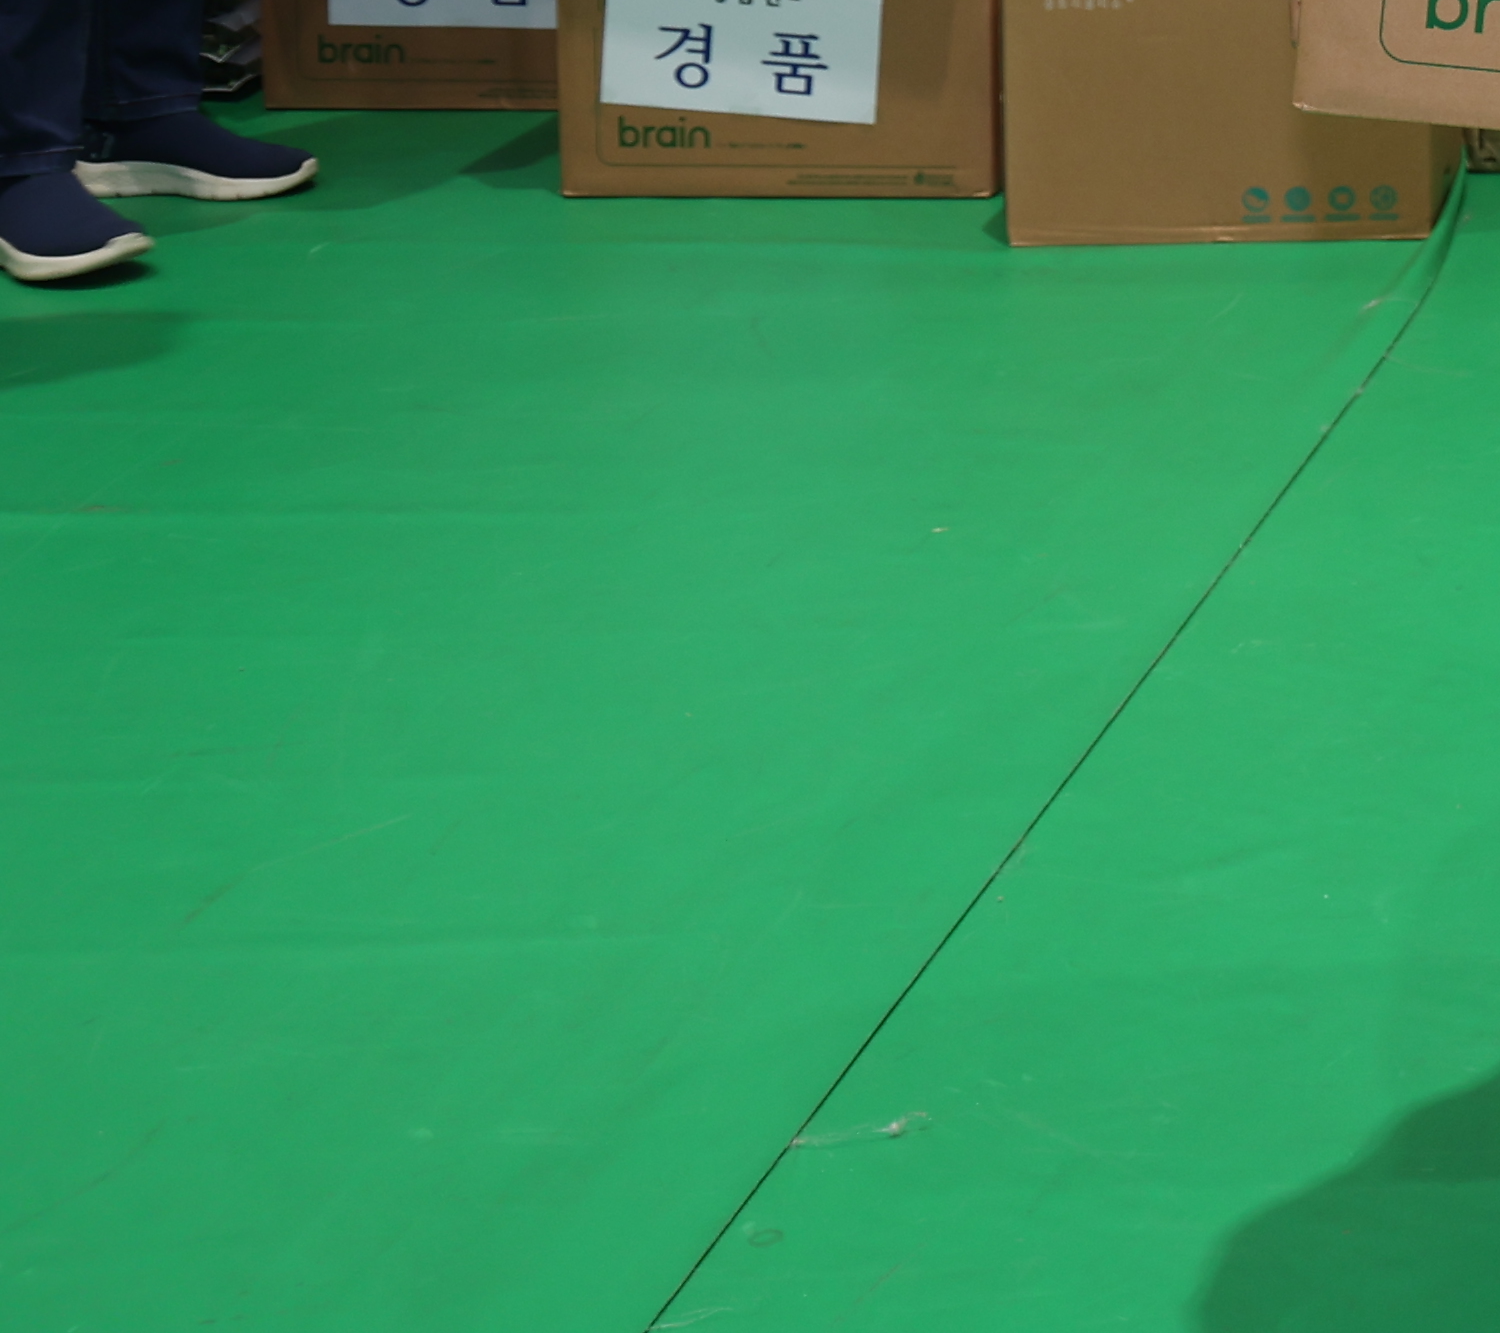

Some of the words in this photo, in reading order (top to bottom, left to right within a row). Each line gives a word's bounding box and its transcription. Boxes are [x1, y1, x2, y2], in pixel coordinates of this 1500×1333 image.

[318, 34, 407, 65] brain
[654, 23, 714, 90] 경
[761, 32, 830, 96] 품
[617, 116, 712, 150] brain
